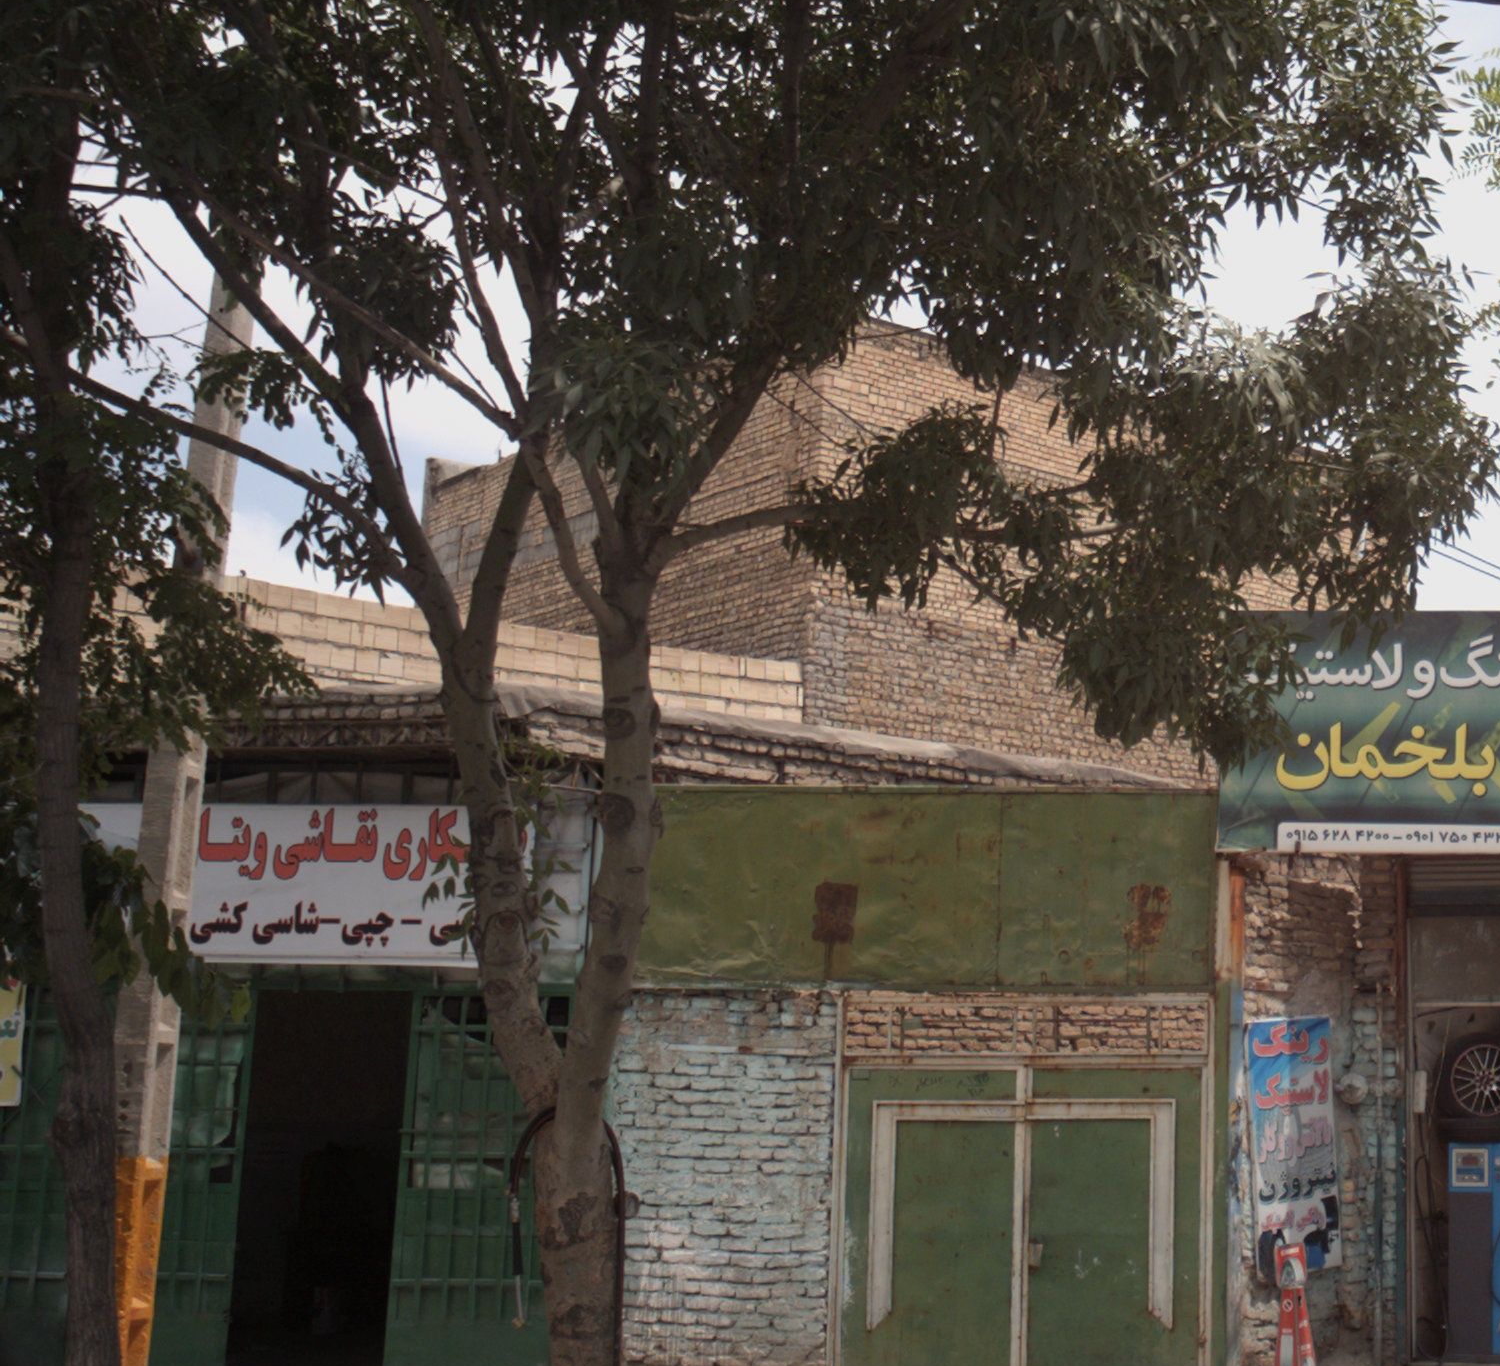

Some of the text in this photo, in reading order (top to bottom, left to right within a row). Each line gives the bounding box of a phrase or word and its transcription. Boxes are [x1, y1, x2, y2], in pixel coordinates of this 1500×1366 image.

[1406, 657, 1436, 699] و
[1275, 721, 1496, 797] بلخمان
[272, 807, 379, 881] نقاشی
[189, 901, 249, 945] کشی
[253, 901, 320, 945] شاسی
[341, 911, 394, 948] چپی
[1255, 1066, 1329, 1116] لاستیک
[1259, 1161, 1337, 1205] نیتروژن
